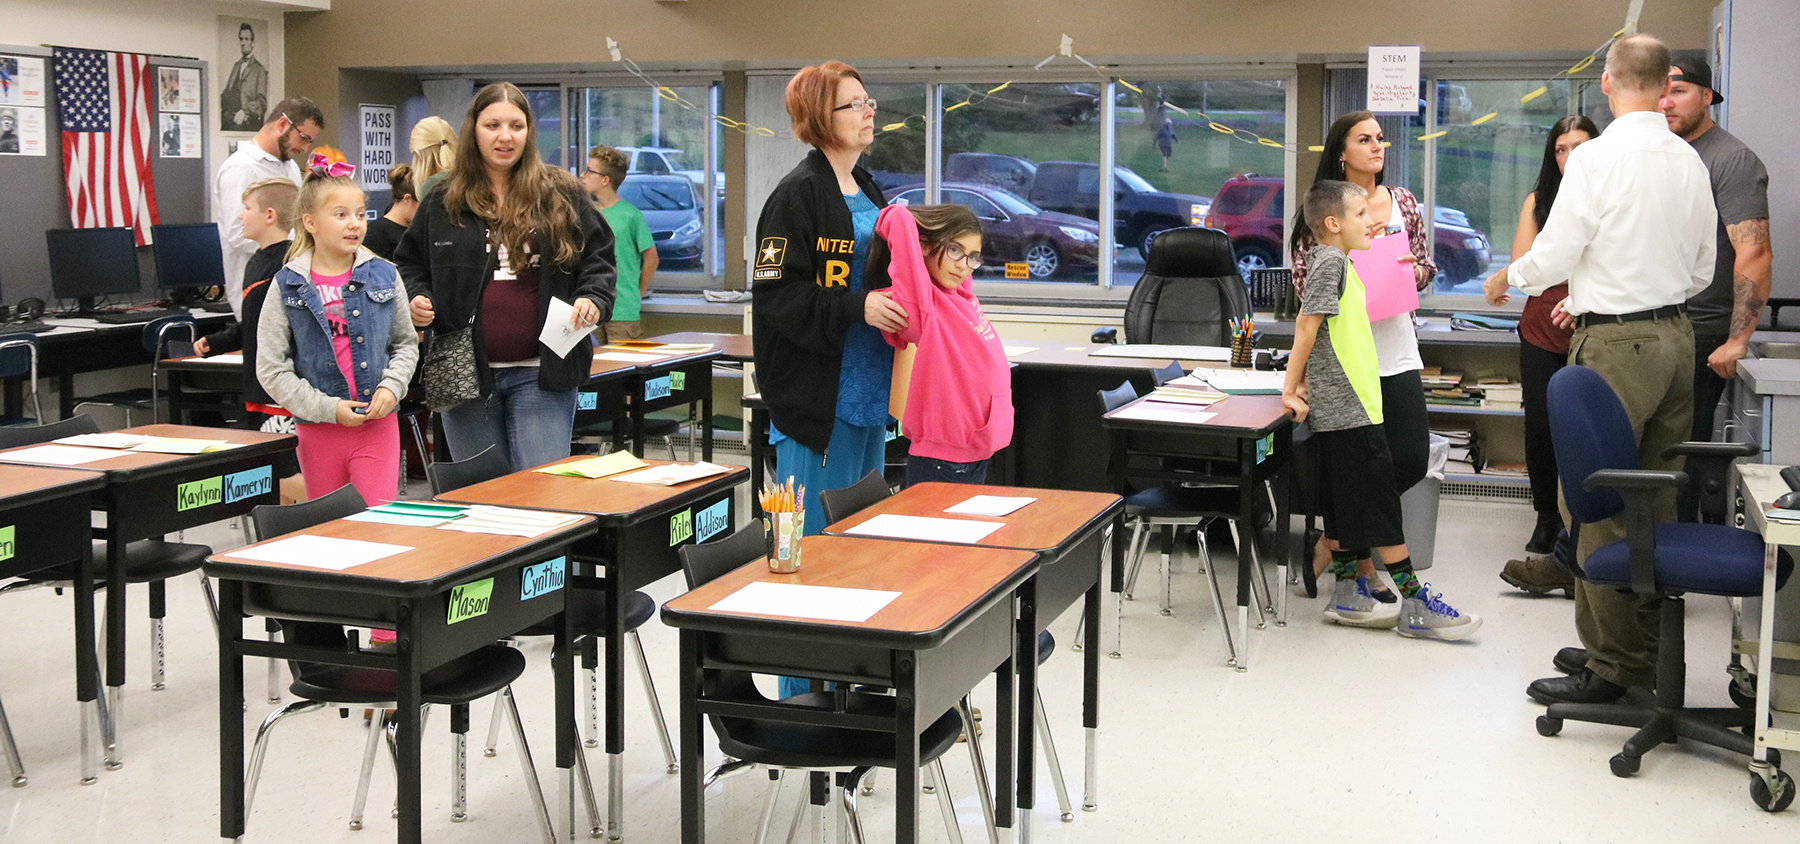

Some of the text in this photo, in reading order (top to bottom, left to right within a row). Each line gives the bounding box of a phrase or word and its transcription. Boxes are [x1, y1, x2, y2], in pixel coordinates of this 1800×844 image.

[1382, 54, 1407, 63] STEM
[365, 113, 391, 128] PASS
[365, 132, 391, 146] WITH
[364, 150, 392, 165] HARD
[645, 382, 671, 399] Madison
[180, 476, 271, 509] Kaylynn Kameryn
[697, 510, 729, 541] Addison
[449, 563, 564, 620] Mason Cynthia
